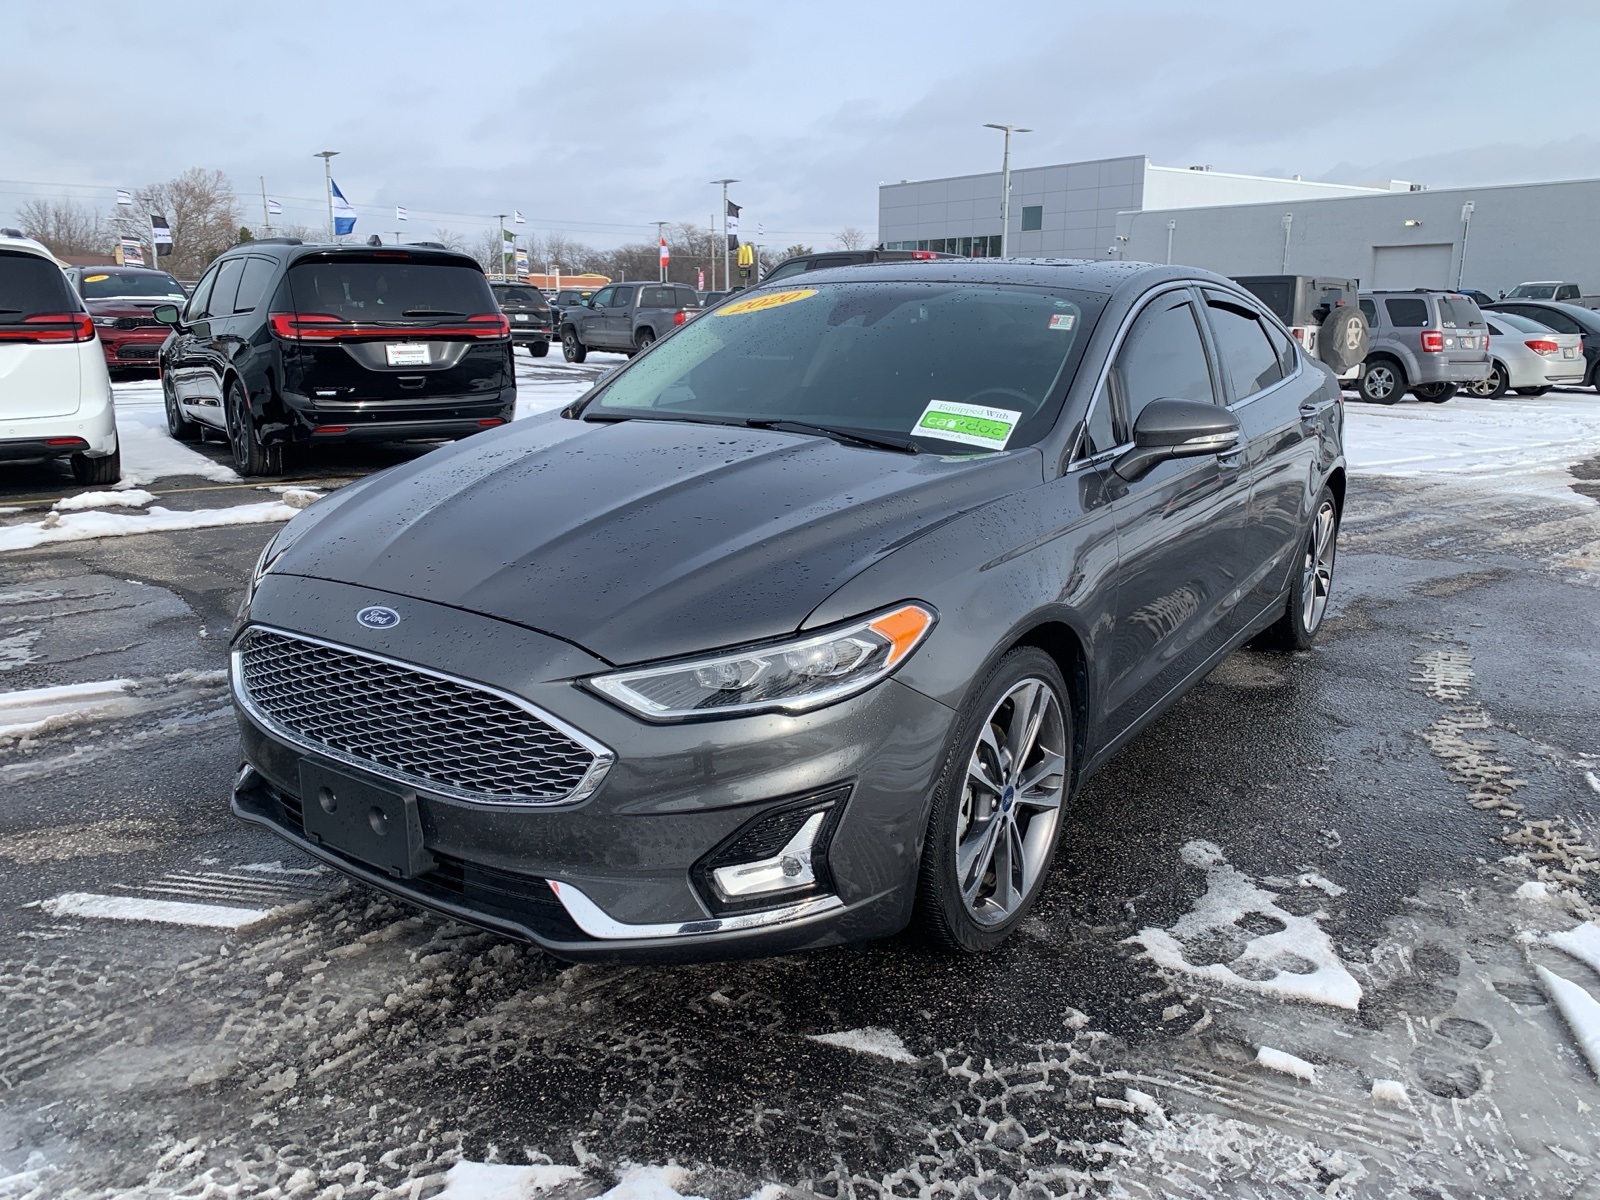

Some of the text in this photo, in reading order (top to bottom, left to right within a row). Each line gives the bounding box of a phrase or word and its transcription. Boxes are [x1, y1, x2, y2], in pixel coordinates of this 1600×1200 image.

[728, 292, 802, 314] 2020
[938, 403, 1009, 420] Equipped With
